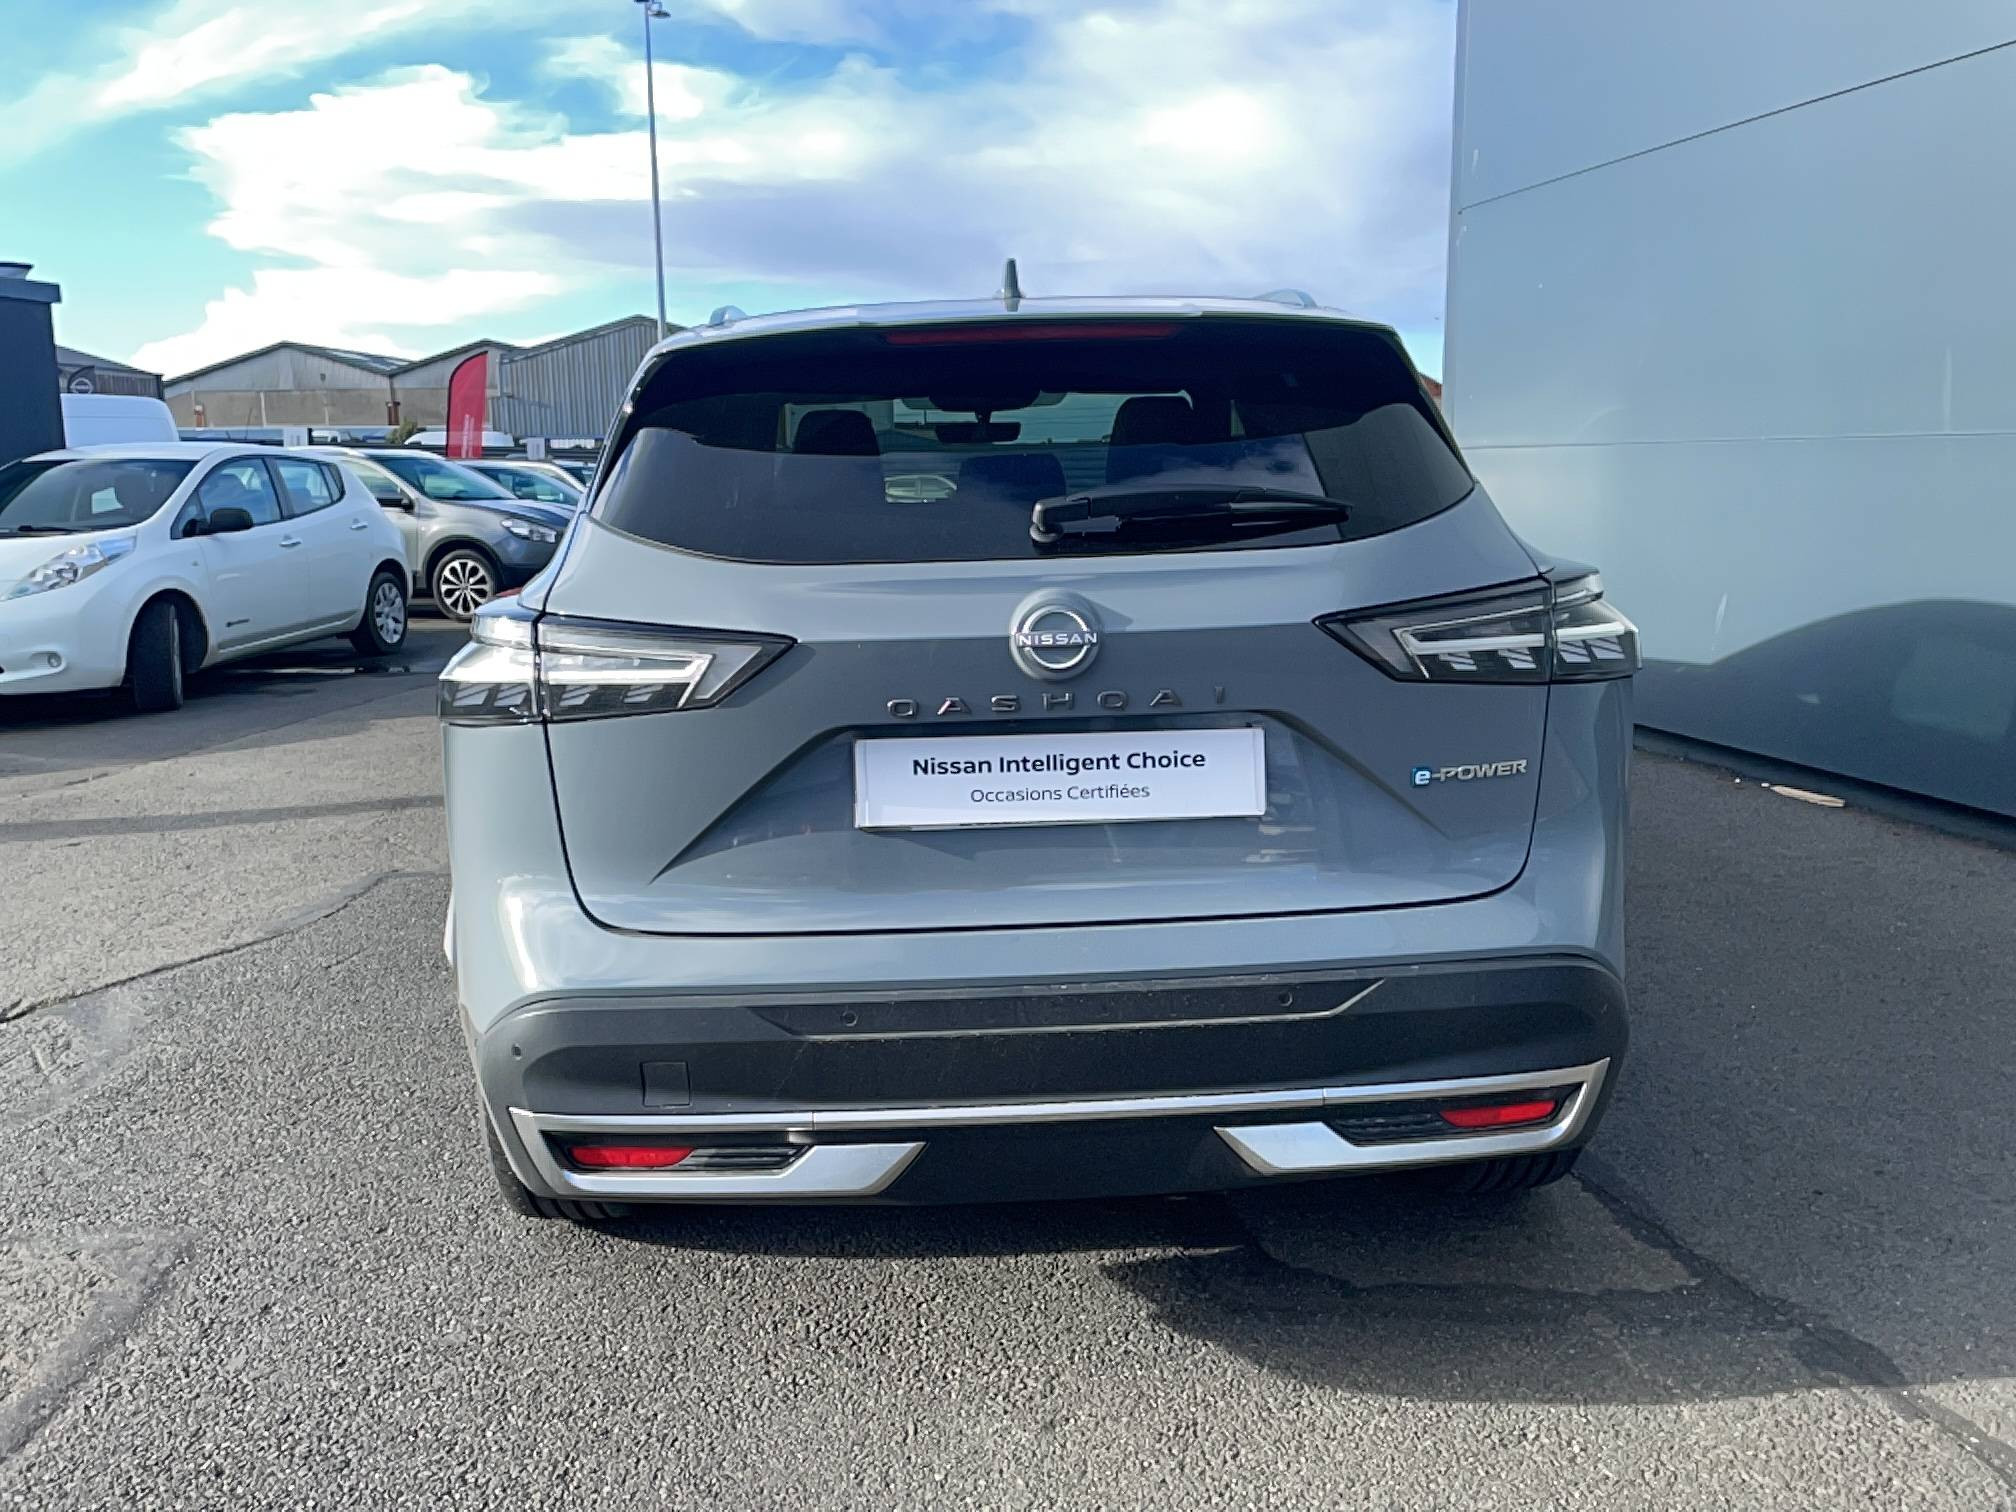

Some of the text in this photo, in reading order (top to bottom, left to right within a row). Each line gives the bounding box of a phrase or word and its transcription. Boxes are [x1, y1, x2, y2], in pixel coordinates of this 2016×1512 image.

[1018, 632, 1098, 646] NISSAN
[887, 686, 1226, 717] QASHQAI
[913, 750, 1206, 776] Nissan Intelligent Choice
[1413, 759, 1528, 786] e-POWER
[970, 783, 1151, 803] Occasions Certifiées
